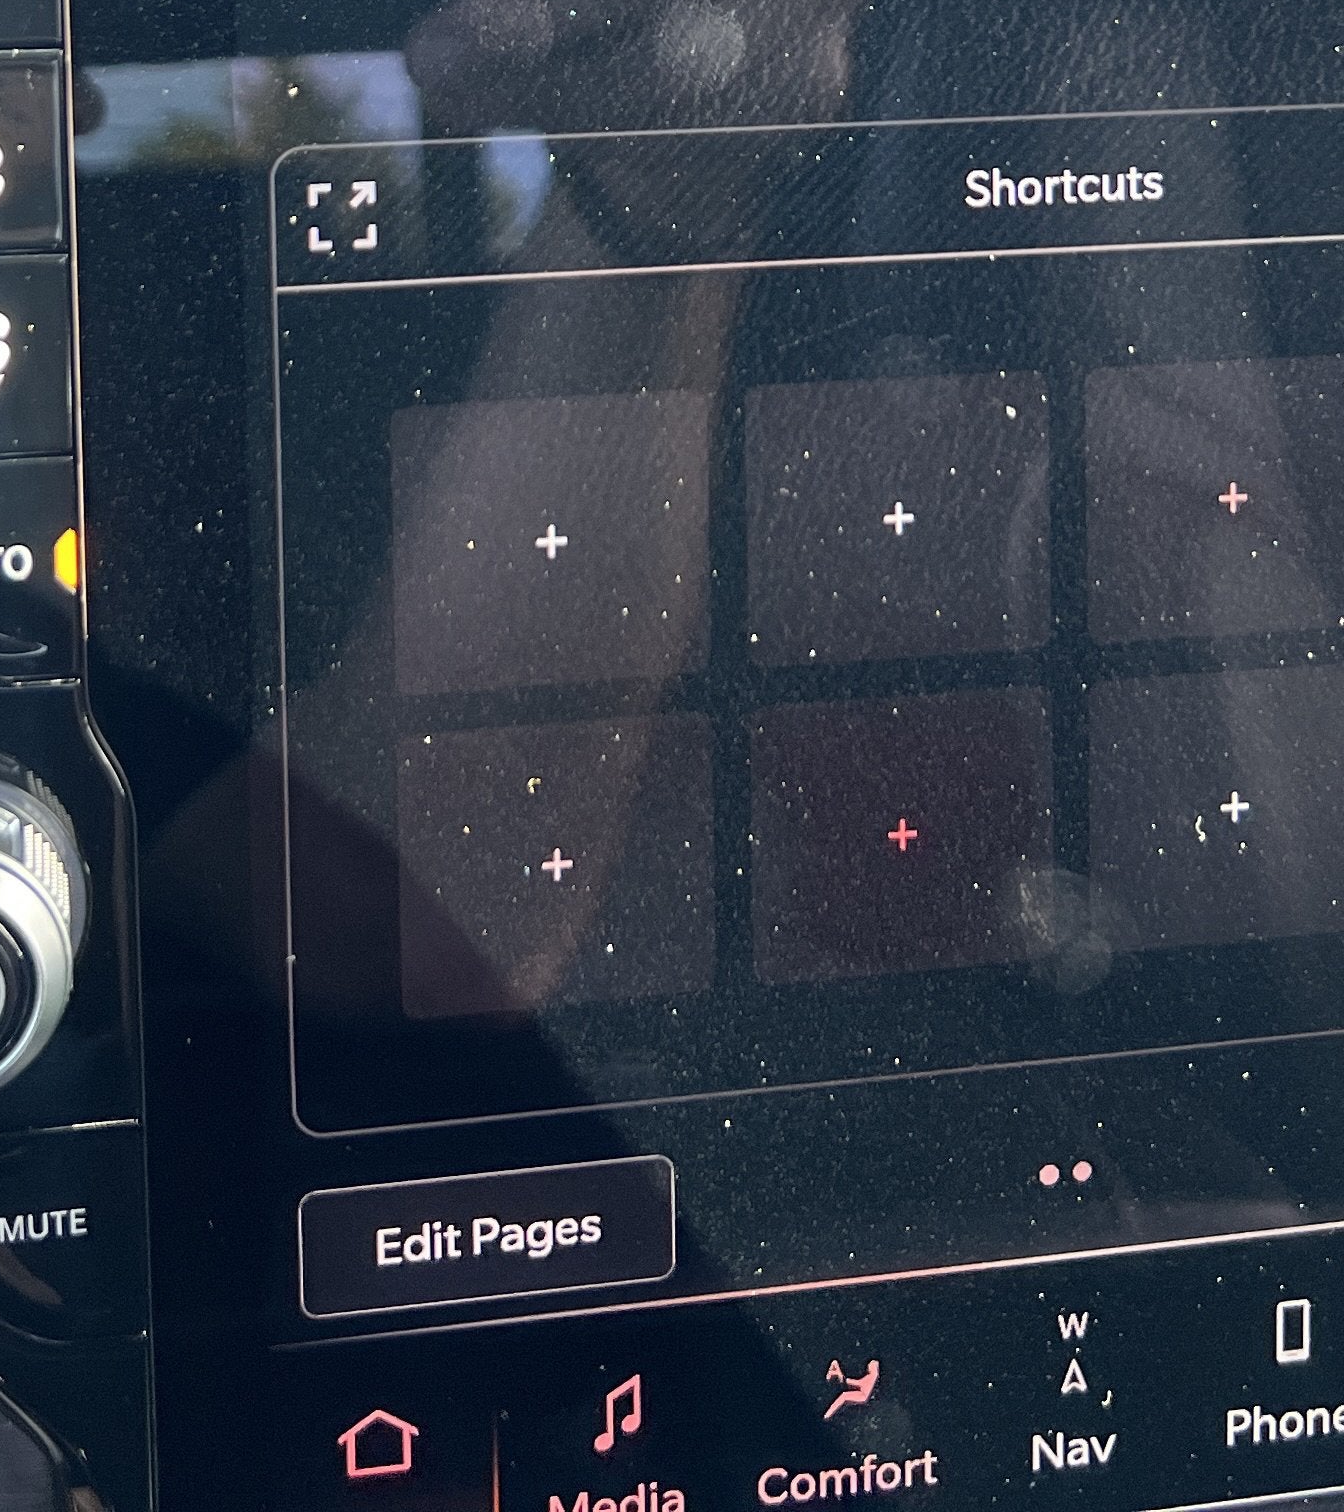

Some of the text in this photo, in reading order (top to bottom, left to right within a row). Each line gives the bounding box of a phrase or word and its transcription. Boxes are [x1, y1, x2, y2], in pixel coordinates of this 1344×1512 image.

[963, 166, 1165, 209] Shortcuts
[375, 1212, 604, 1266] Edit Pages
[1031, 1430, 1118, 1471] Nav
[757, 1450, 939, 1507] Comfort
